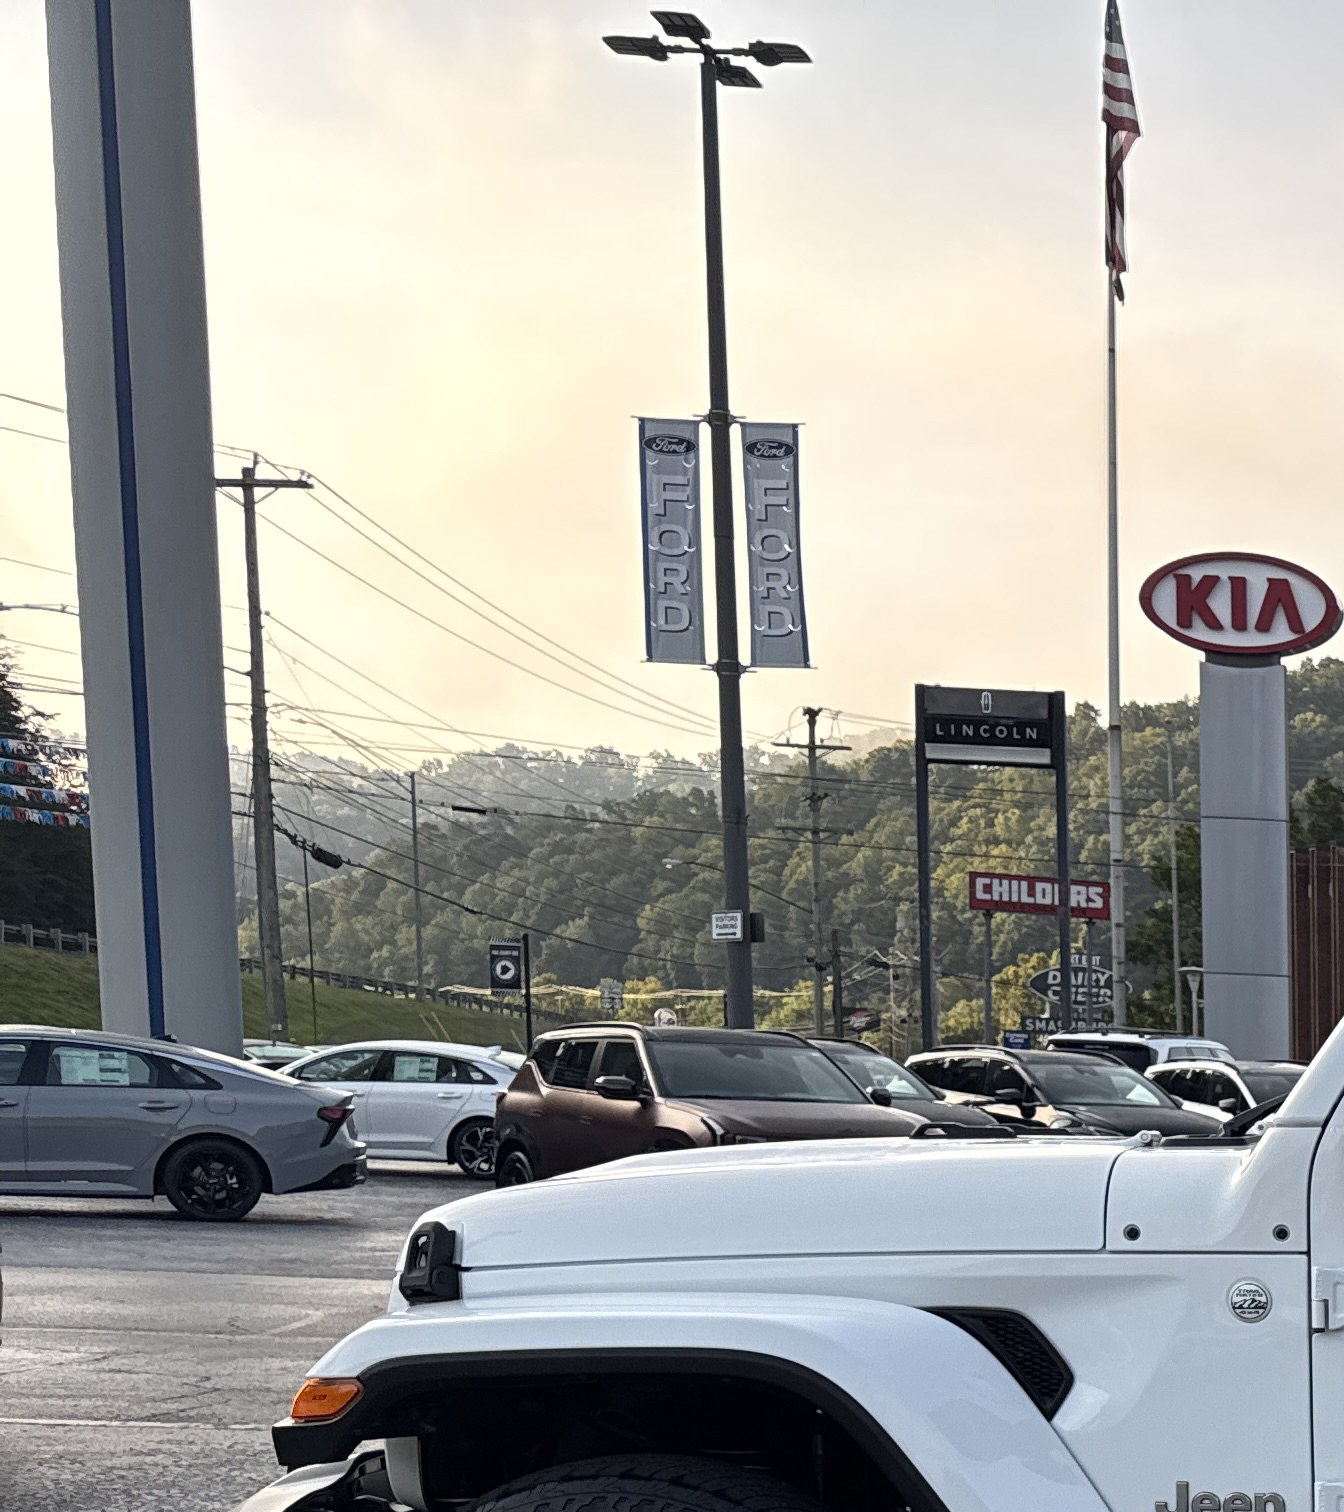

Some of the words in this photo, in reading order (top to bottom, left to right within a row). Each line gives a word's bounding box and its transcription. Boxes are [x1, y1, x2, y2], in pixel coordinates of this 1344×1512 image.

[652, 435, 688, 454] Ford
[754, 441, 787, 457] Ford
[652, 474, 693, 633] FORD
[753, 479, 796, 638] FORD
[1173, 573, 1306, 635] KIA
[936, 723, 1038, 740] LINCOLN
